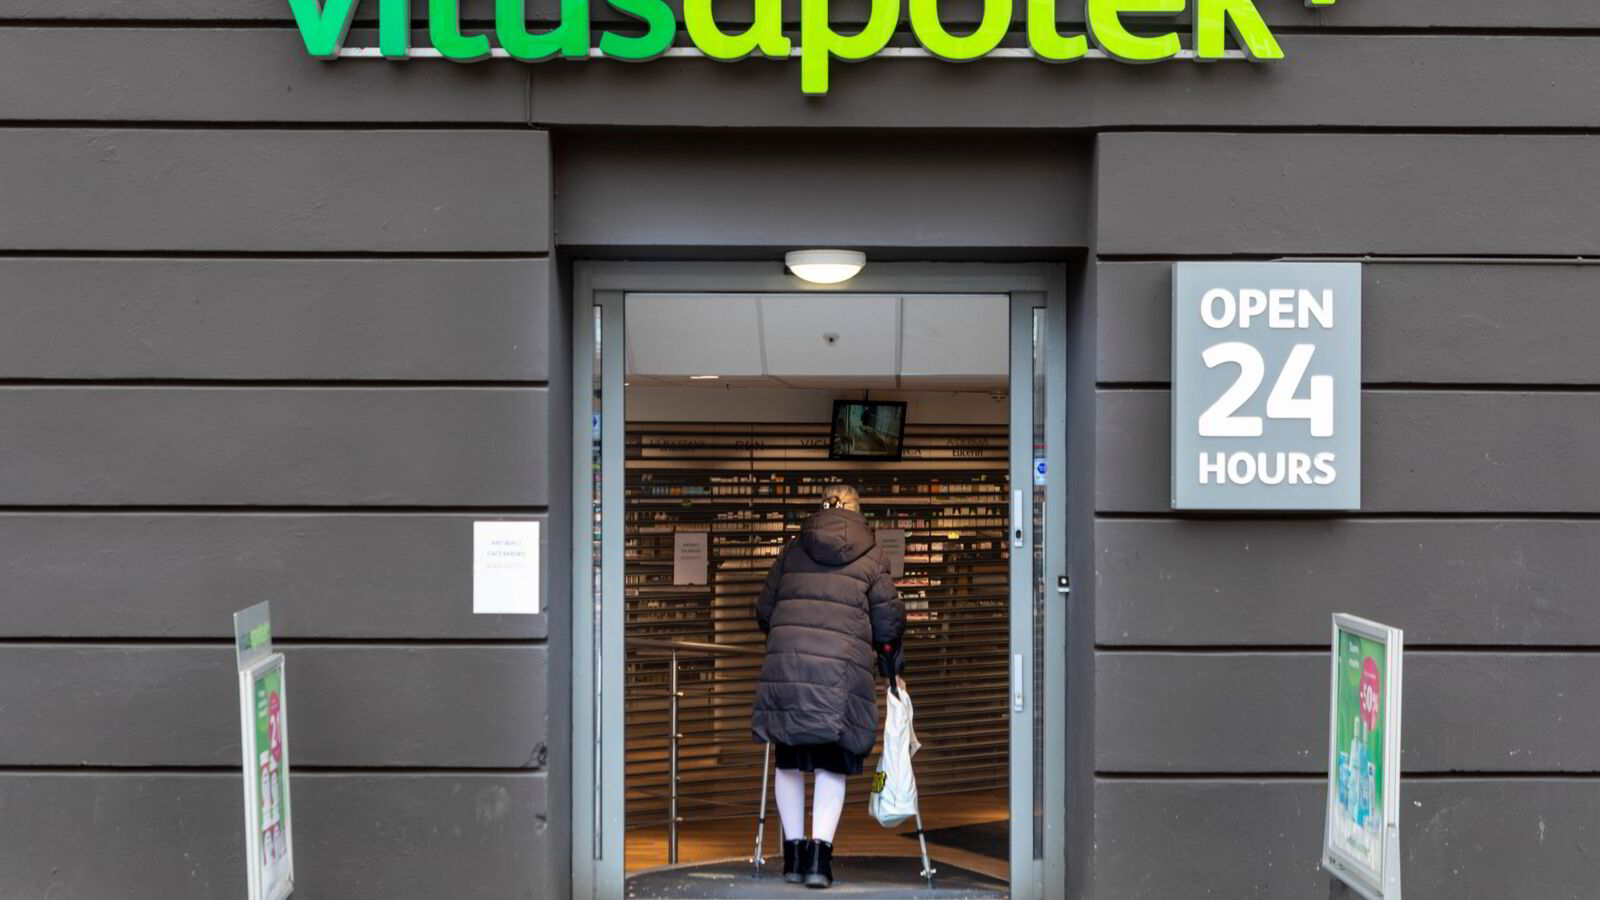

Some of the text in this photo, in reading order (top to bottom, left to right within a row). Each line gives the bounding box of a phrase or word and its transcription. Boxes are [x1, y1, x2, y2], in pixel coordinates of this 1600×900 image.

[1200, 288, 1333, 328] OPEN
[1198, 342, 1334, 437] 24
[1199, 452, 1336, 485] HOURS
